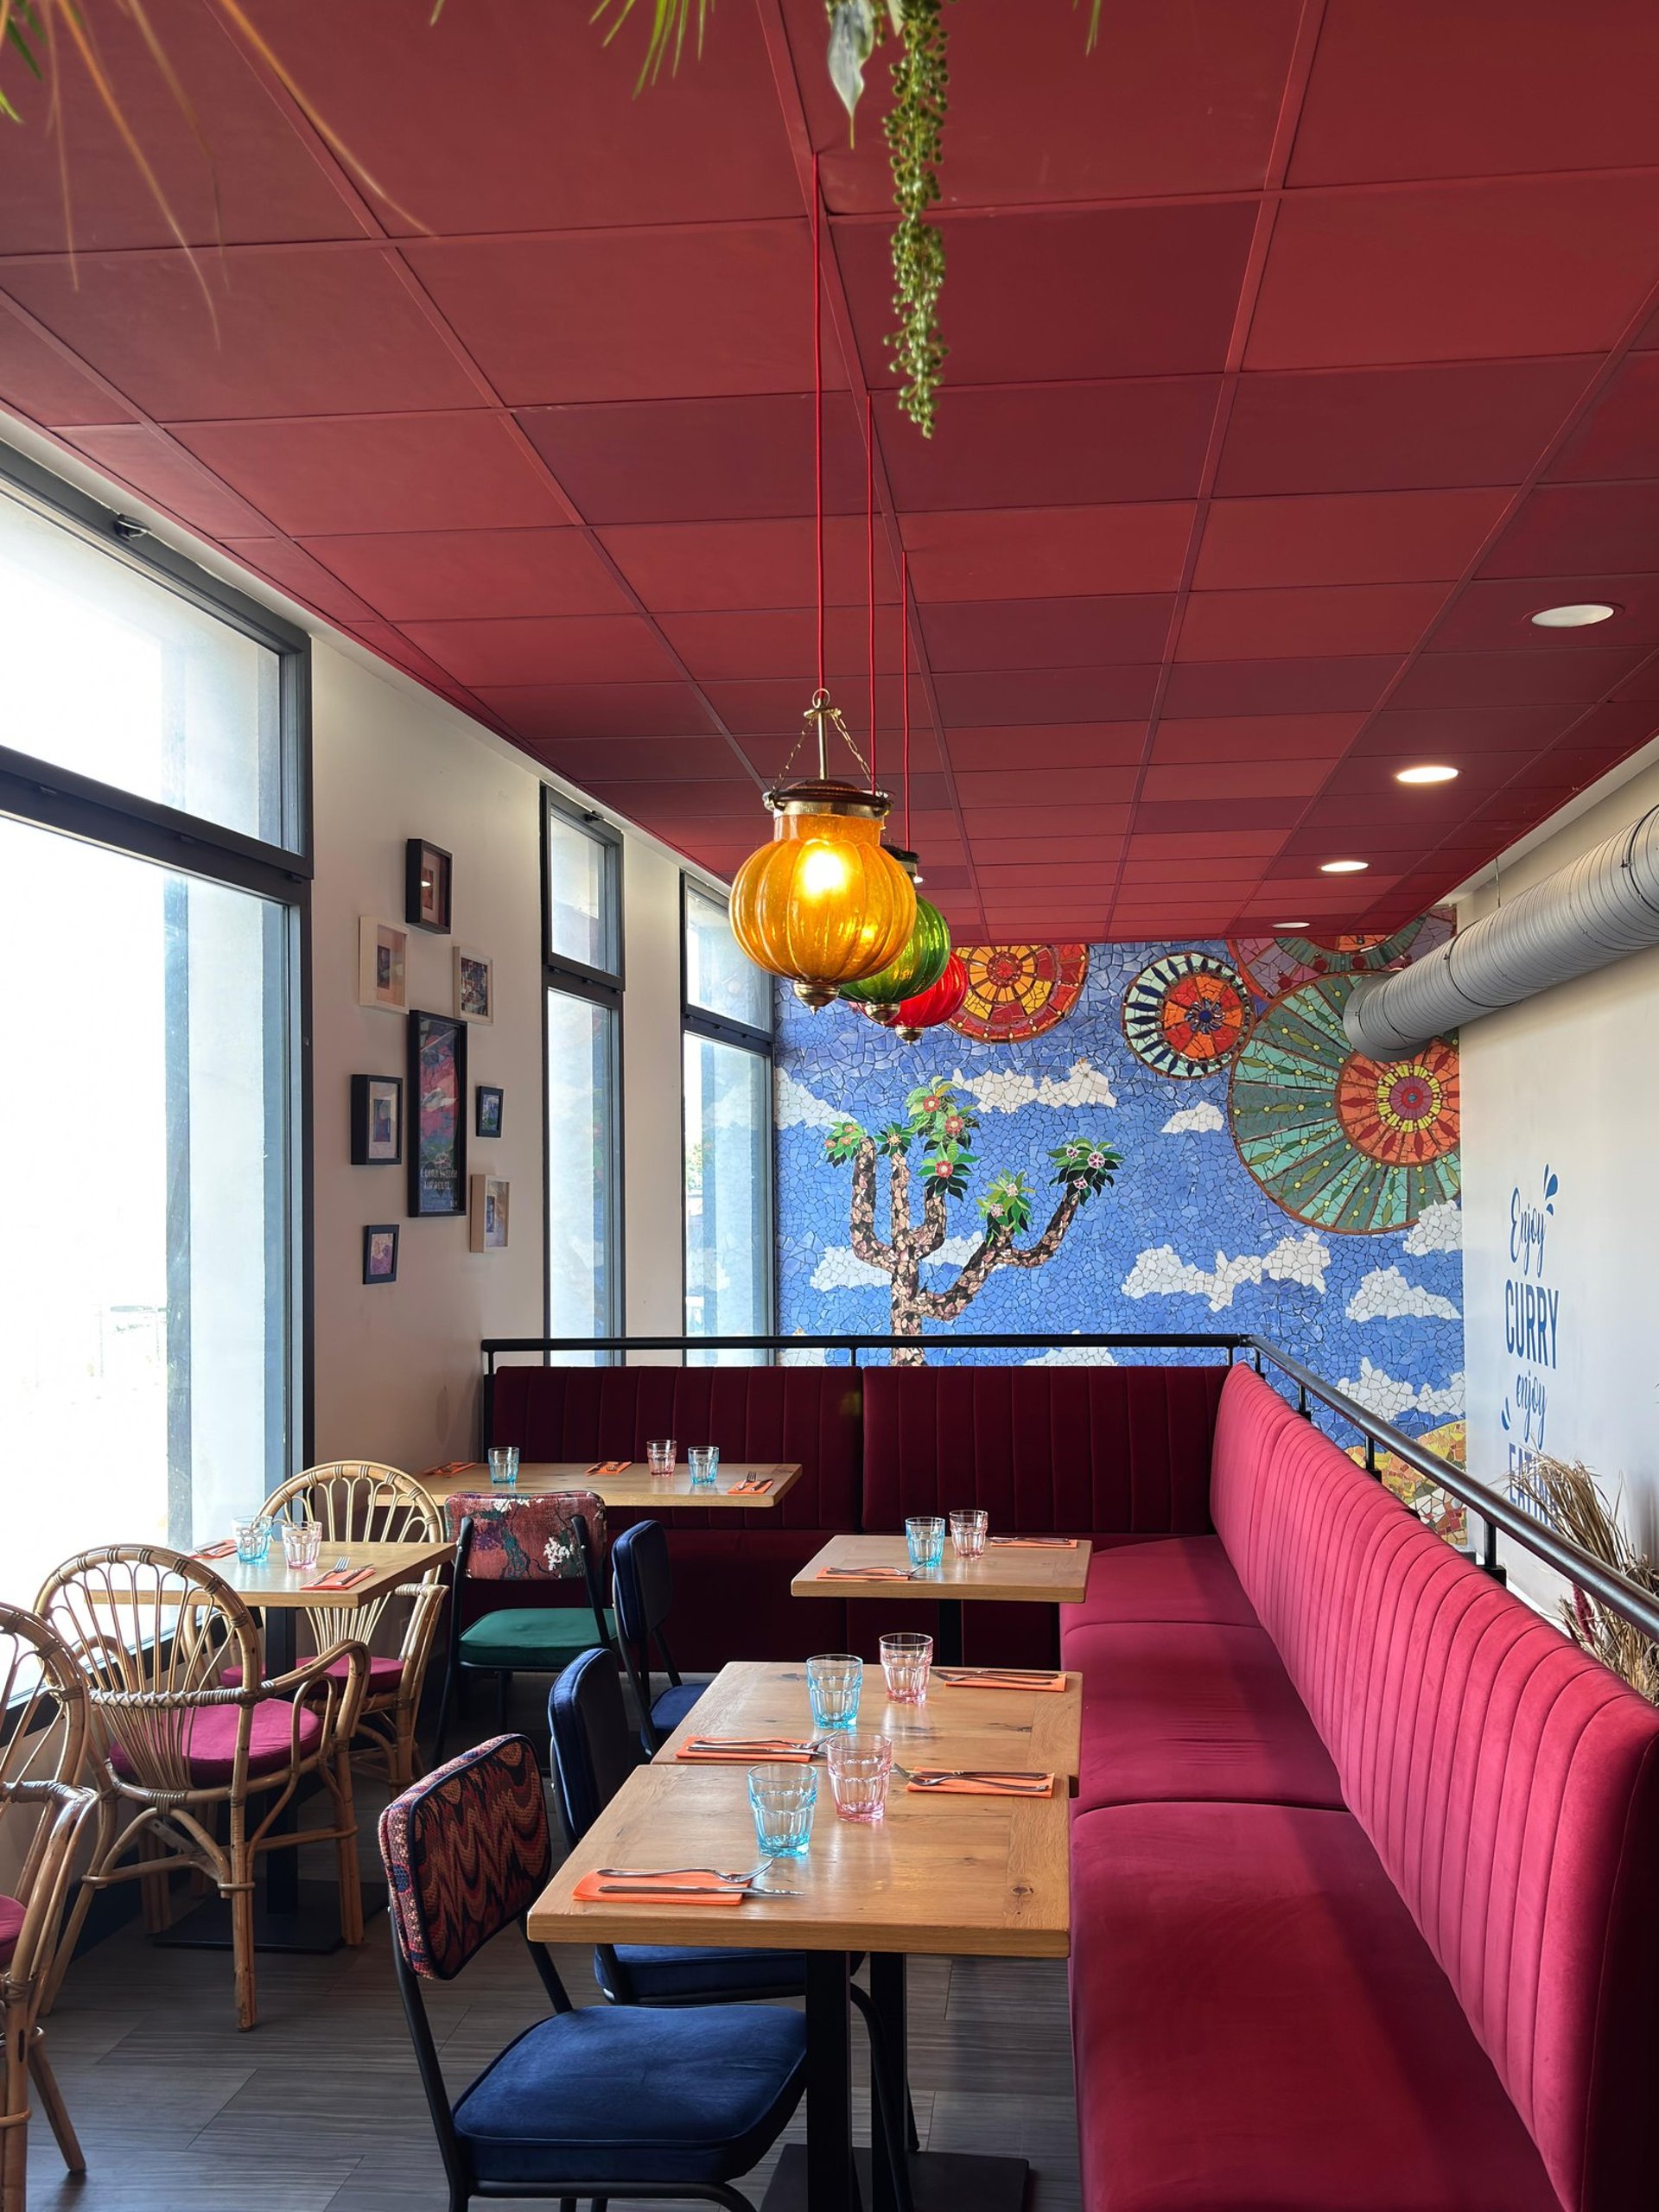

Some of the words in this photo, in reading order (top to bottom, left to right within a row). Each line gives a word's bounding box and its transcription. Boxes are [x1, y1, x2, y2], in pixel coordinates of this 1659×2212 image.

[1510, 1186, 1547, 1279] Enjoy
[1505, 1278, 1560, 1370] CURRY
[1516, 1369, 1548, 1451] enjoy
[1508, 1441, 1558, 1531] EATIN
